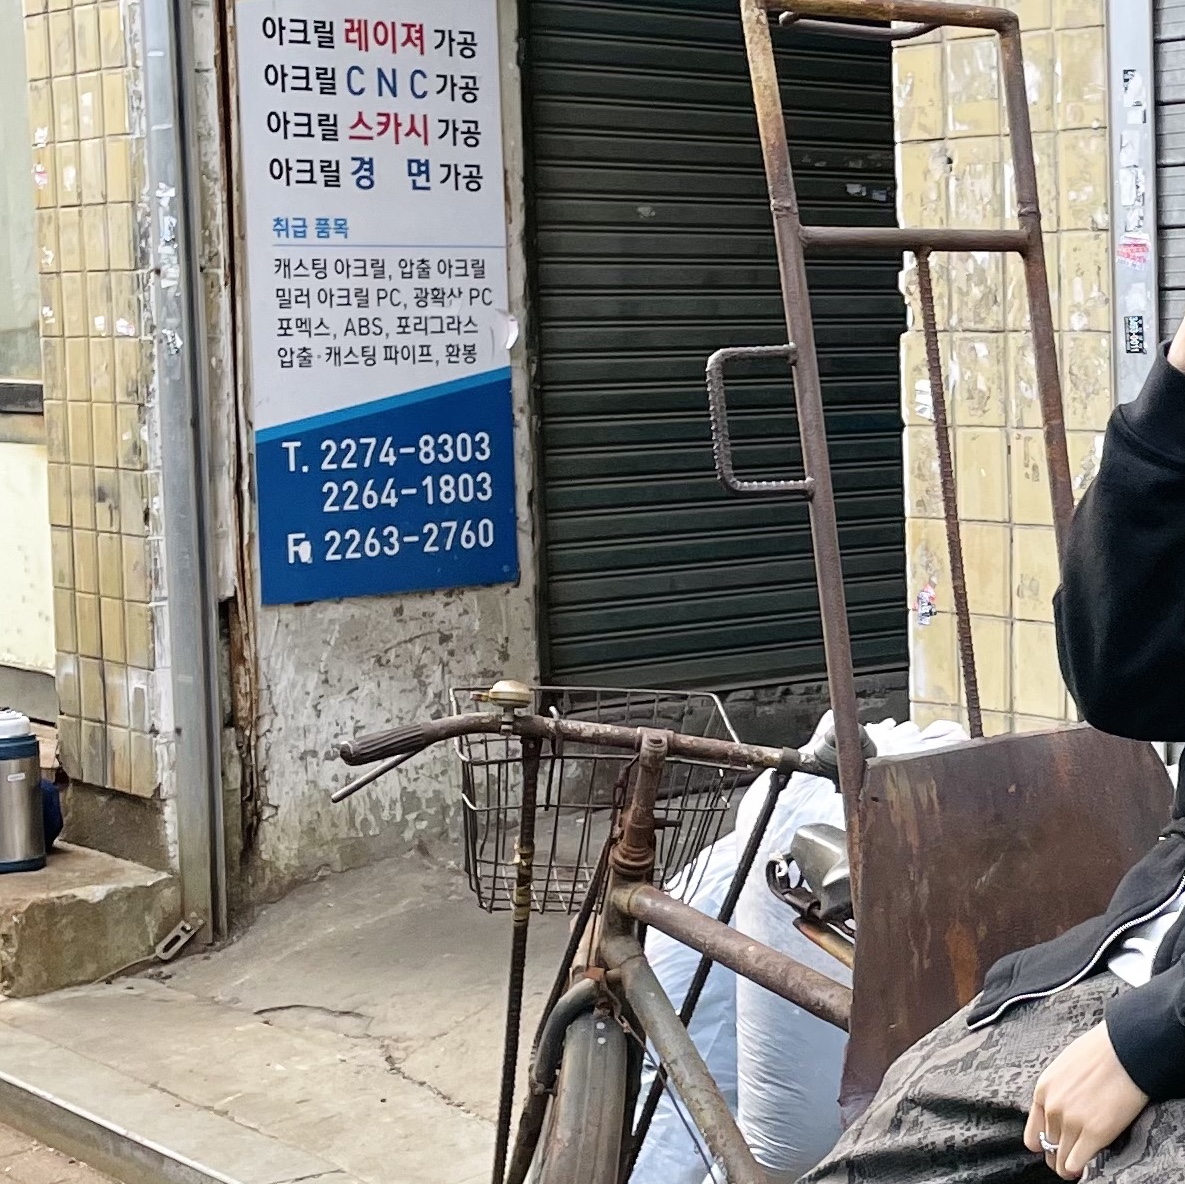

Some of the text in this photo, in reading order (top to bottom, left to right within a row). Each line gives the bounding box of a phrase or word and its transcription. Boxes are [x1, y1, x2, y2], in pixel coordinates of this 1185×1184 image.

[262, 16, 478, 59] 아크릴 레이져 가공
[264, 63, 337, 96] 아크릴
[435, 74, 480, 104] 가공
[266, 111, 481, 148] 아크릴 스카시 가공
[269, 158, 341, 188] 아크릴
[439, 163, 484, 193] 가공
[272, 217, 349, 239] 취급 품목
[274, 258, 486, 281] 캐스팅 아크릴, 압출 아크릴
[276, 287, 311, 309] 밀러
[317, 287, 369, 309] 아크릴
[376, 287, 408, 310] PC,
[469, 287, 493, 307] PC
[276, 315, 479, 340] 포멕스, ABS, 포리그라스
[383, 343, 440, 367] 파이프,
[445, 343, 478, 365] 환봉
[281, 431, 491, 473] T. 2274-8303
[321, 471, 493, 513] 2264-1803
[324, 518, 494, 562] 2263-2760
